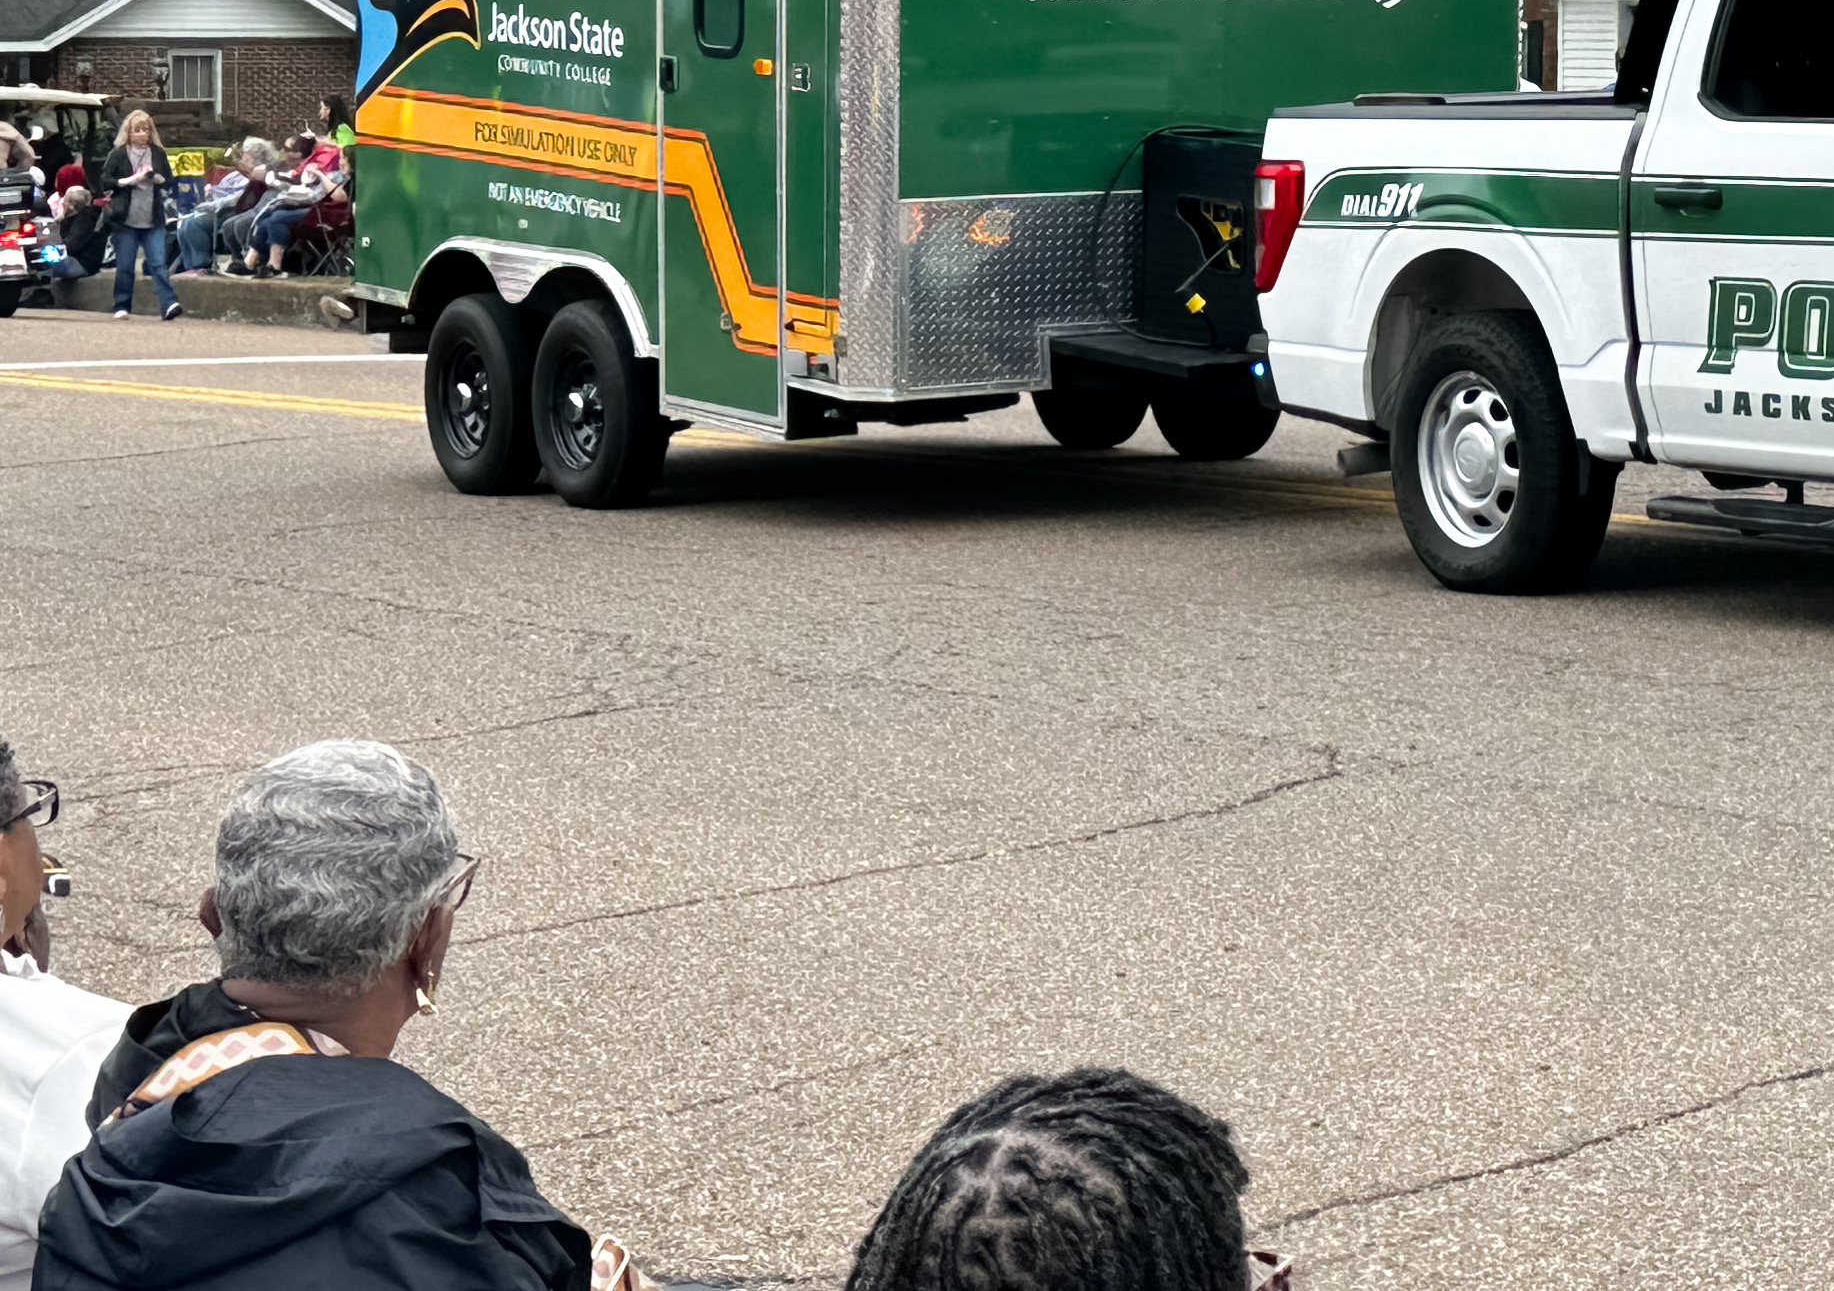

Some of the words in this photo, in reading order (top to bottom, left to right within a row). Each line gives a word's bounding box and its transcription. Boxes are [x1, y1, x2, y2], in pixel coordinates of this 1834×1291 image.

[488, 1, 567, 50] Jackson
[569, 11, 625, 58] State
[565, 62, 611, 86] COLLEGE
[577, 136, 601, 160] USE
[603, 140, 637, 167] ONLY
[1341, 194, 1378, 217] DIAL
[1377, 182, 1424, 219] 911
